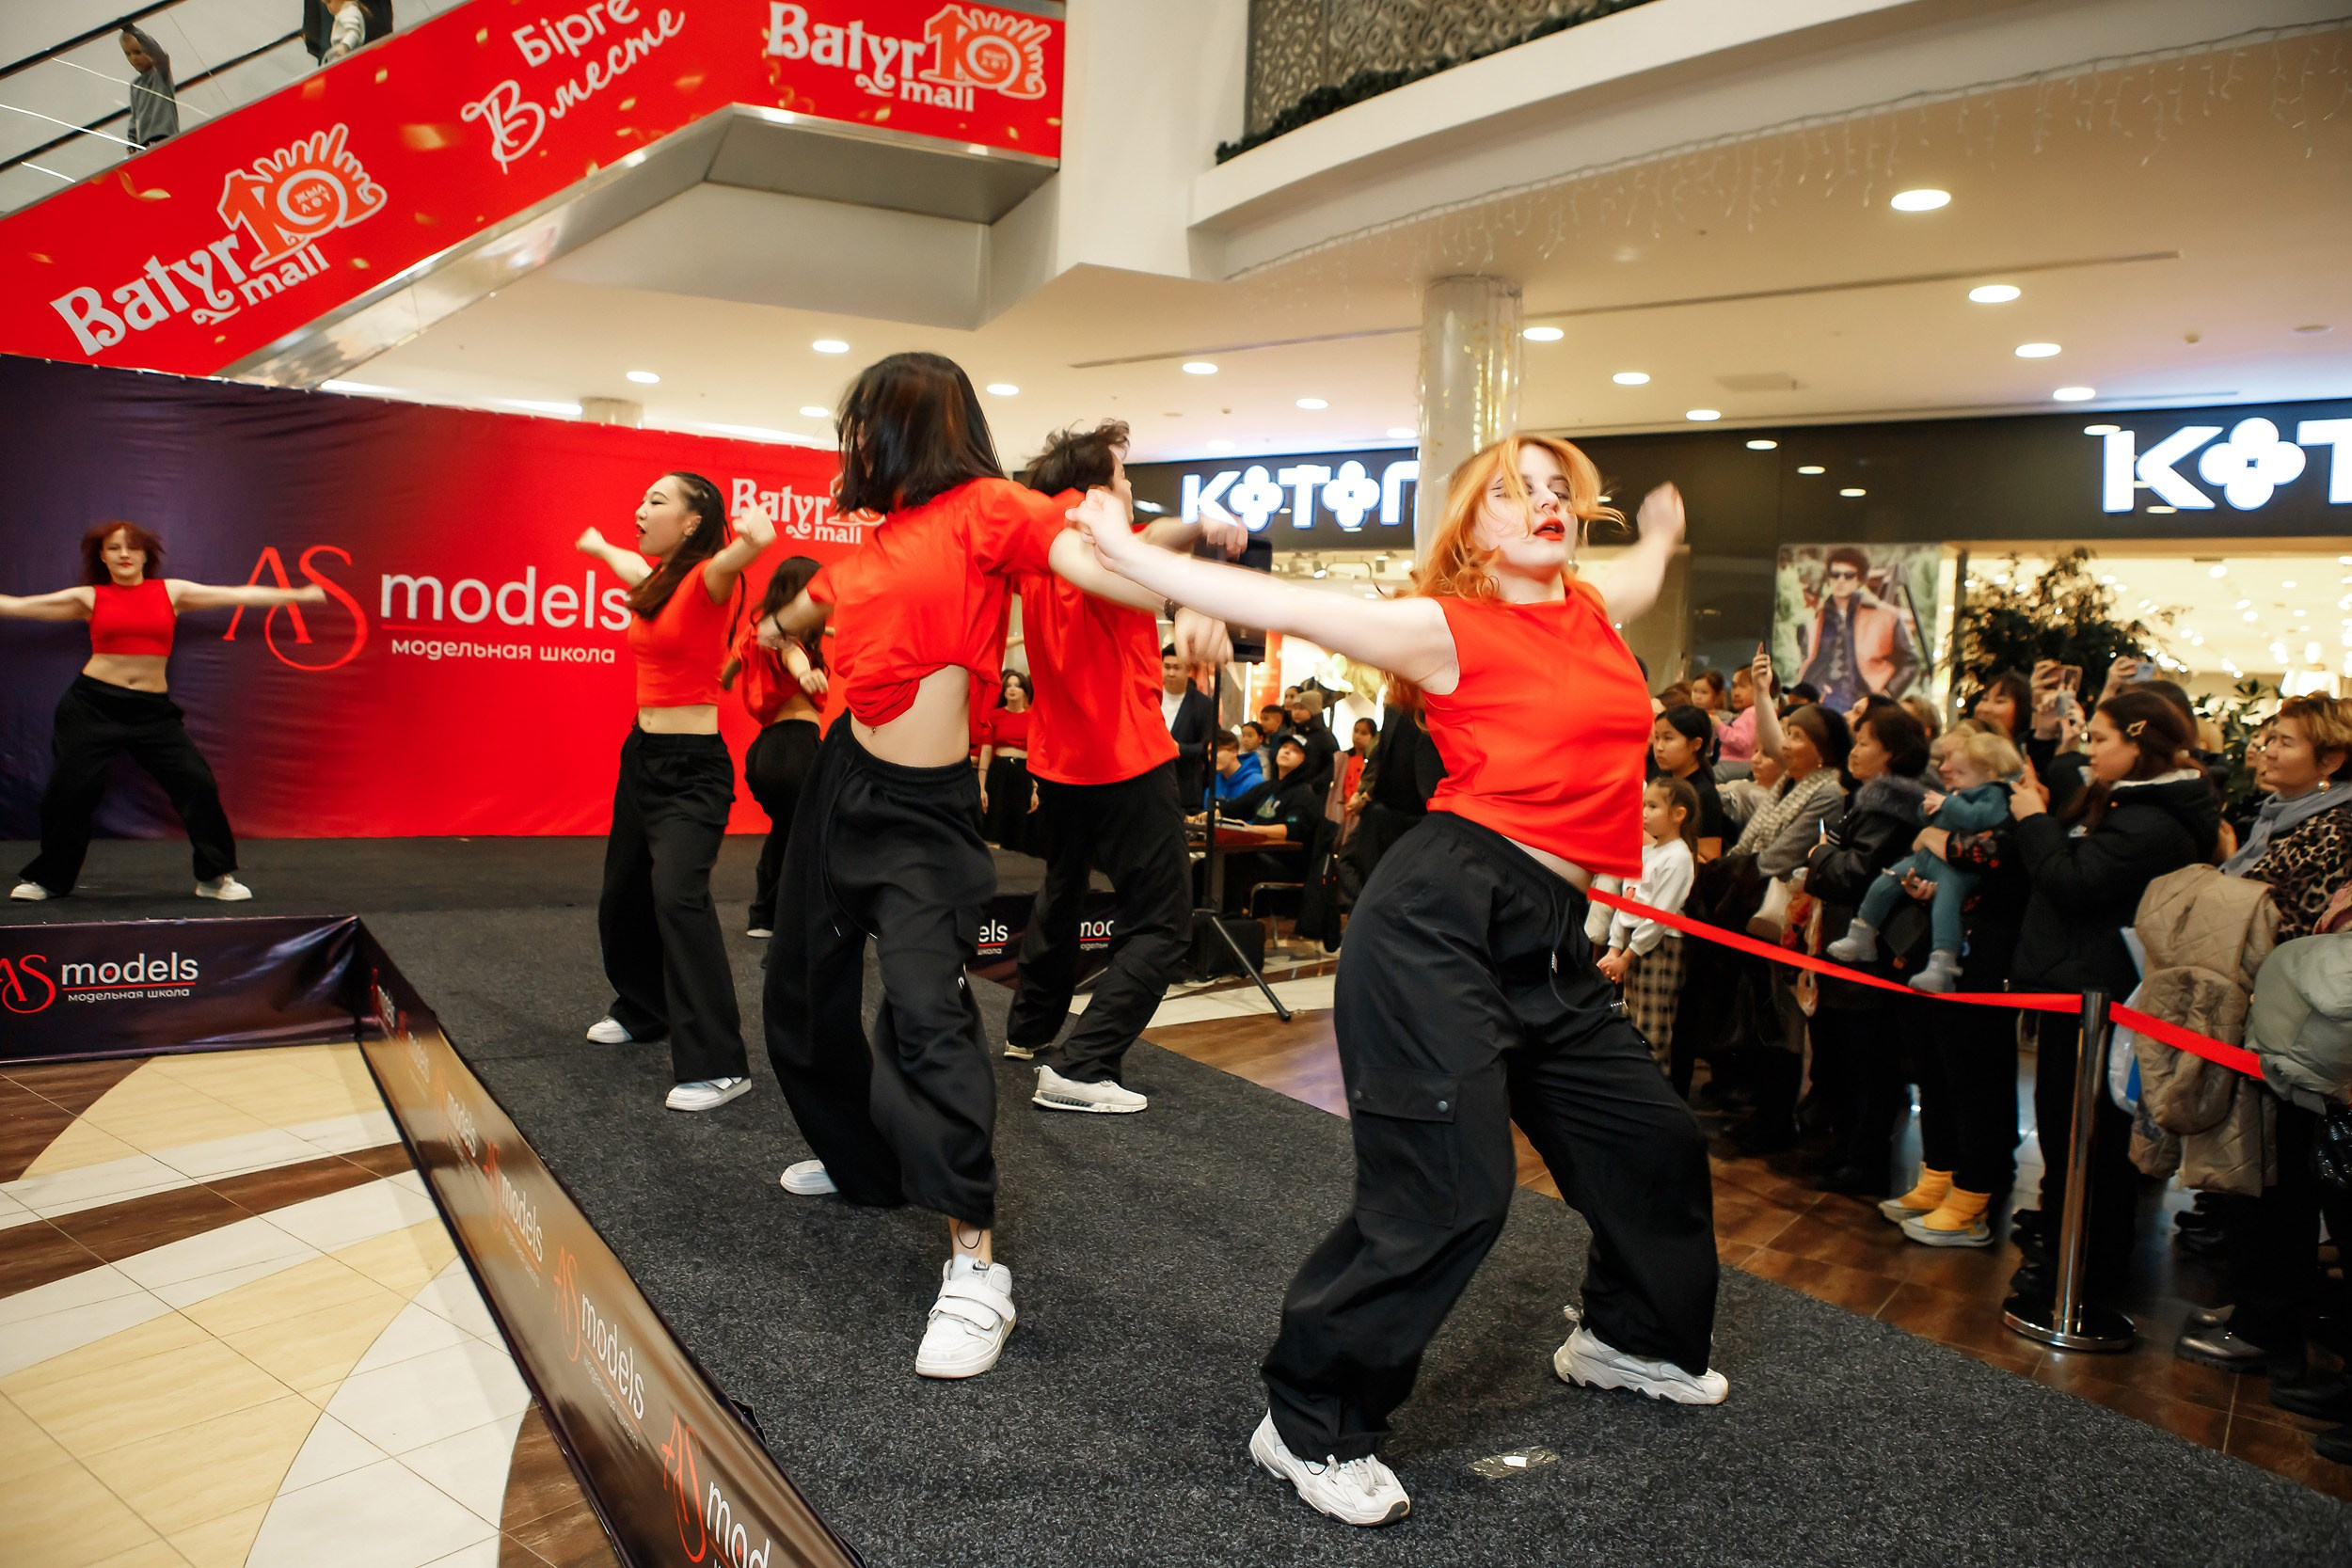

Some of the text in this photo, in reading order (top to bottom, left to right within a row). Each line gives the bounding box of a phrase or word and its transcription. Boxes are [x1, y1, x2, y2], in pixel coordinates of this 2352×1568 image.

[512, 0, 640, 68] Бірге
[768, 1, 927, 95] Batyr
[461, 8, 686, 175] Вместе
[900, 79, 975, 112] mall
[50, 234, 247, 356] Batyr
[239, 244, 331, 307] mall
[730, 478, 832, 539] Batyr
[814, 526, 862, 545] mall
[222, 545, 632, 671] AS models
[391, 639, 616, 663] модельная школа
[61, 951, 199, 986] models
[68, 989, 190, 1004] модельная школа
[501, 1173, 543, 1262] models
[581, 1293, 644, 1419] models
[661, 1409, 706, 1563] AS
